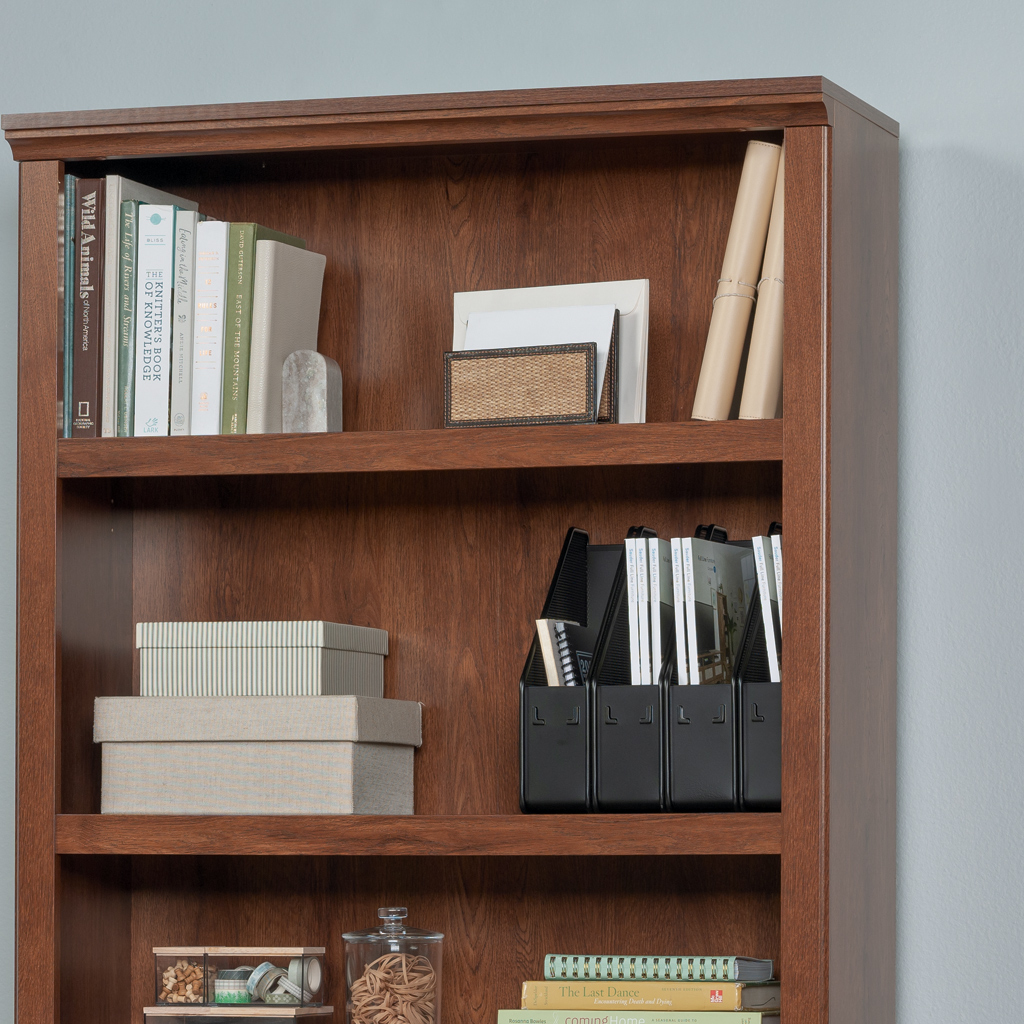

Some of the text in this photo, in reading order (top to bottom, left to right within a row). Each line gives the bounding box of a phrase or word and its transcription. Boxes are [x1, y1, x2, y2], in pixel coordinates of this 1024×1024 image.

[81, 190, 97, 230] Wild
[124, 212, 134, 228] The
[121, 231, 134, 250] Life
[79, 230, 96, 299] Animals
[123, 265, 133, 292] Rivers
[82, 306, 90, 325] North
[235, 294, 243, 315] EAST
[122, 314, 132, 347] Streams
[142, 281, 154, 381] OF KNOWLEDGE
[153, 281, 164, 381] KNITTER'S BOOK
[235, 317, 242, 328] OF
[82, 325, 90, 351] America
[231, 350, 240, 401] MOUNTAINS
[559, 986, 640, 998] The Last Dance
[593, 998, 628, 1006] Encountering
[656, 998, 673, 1006] Dying
